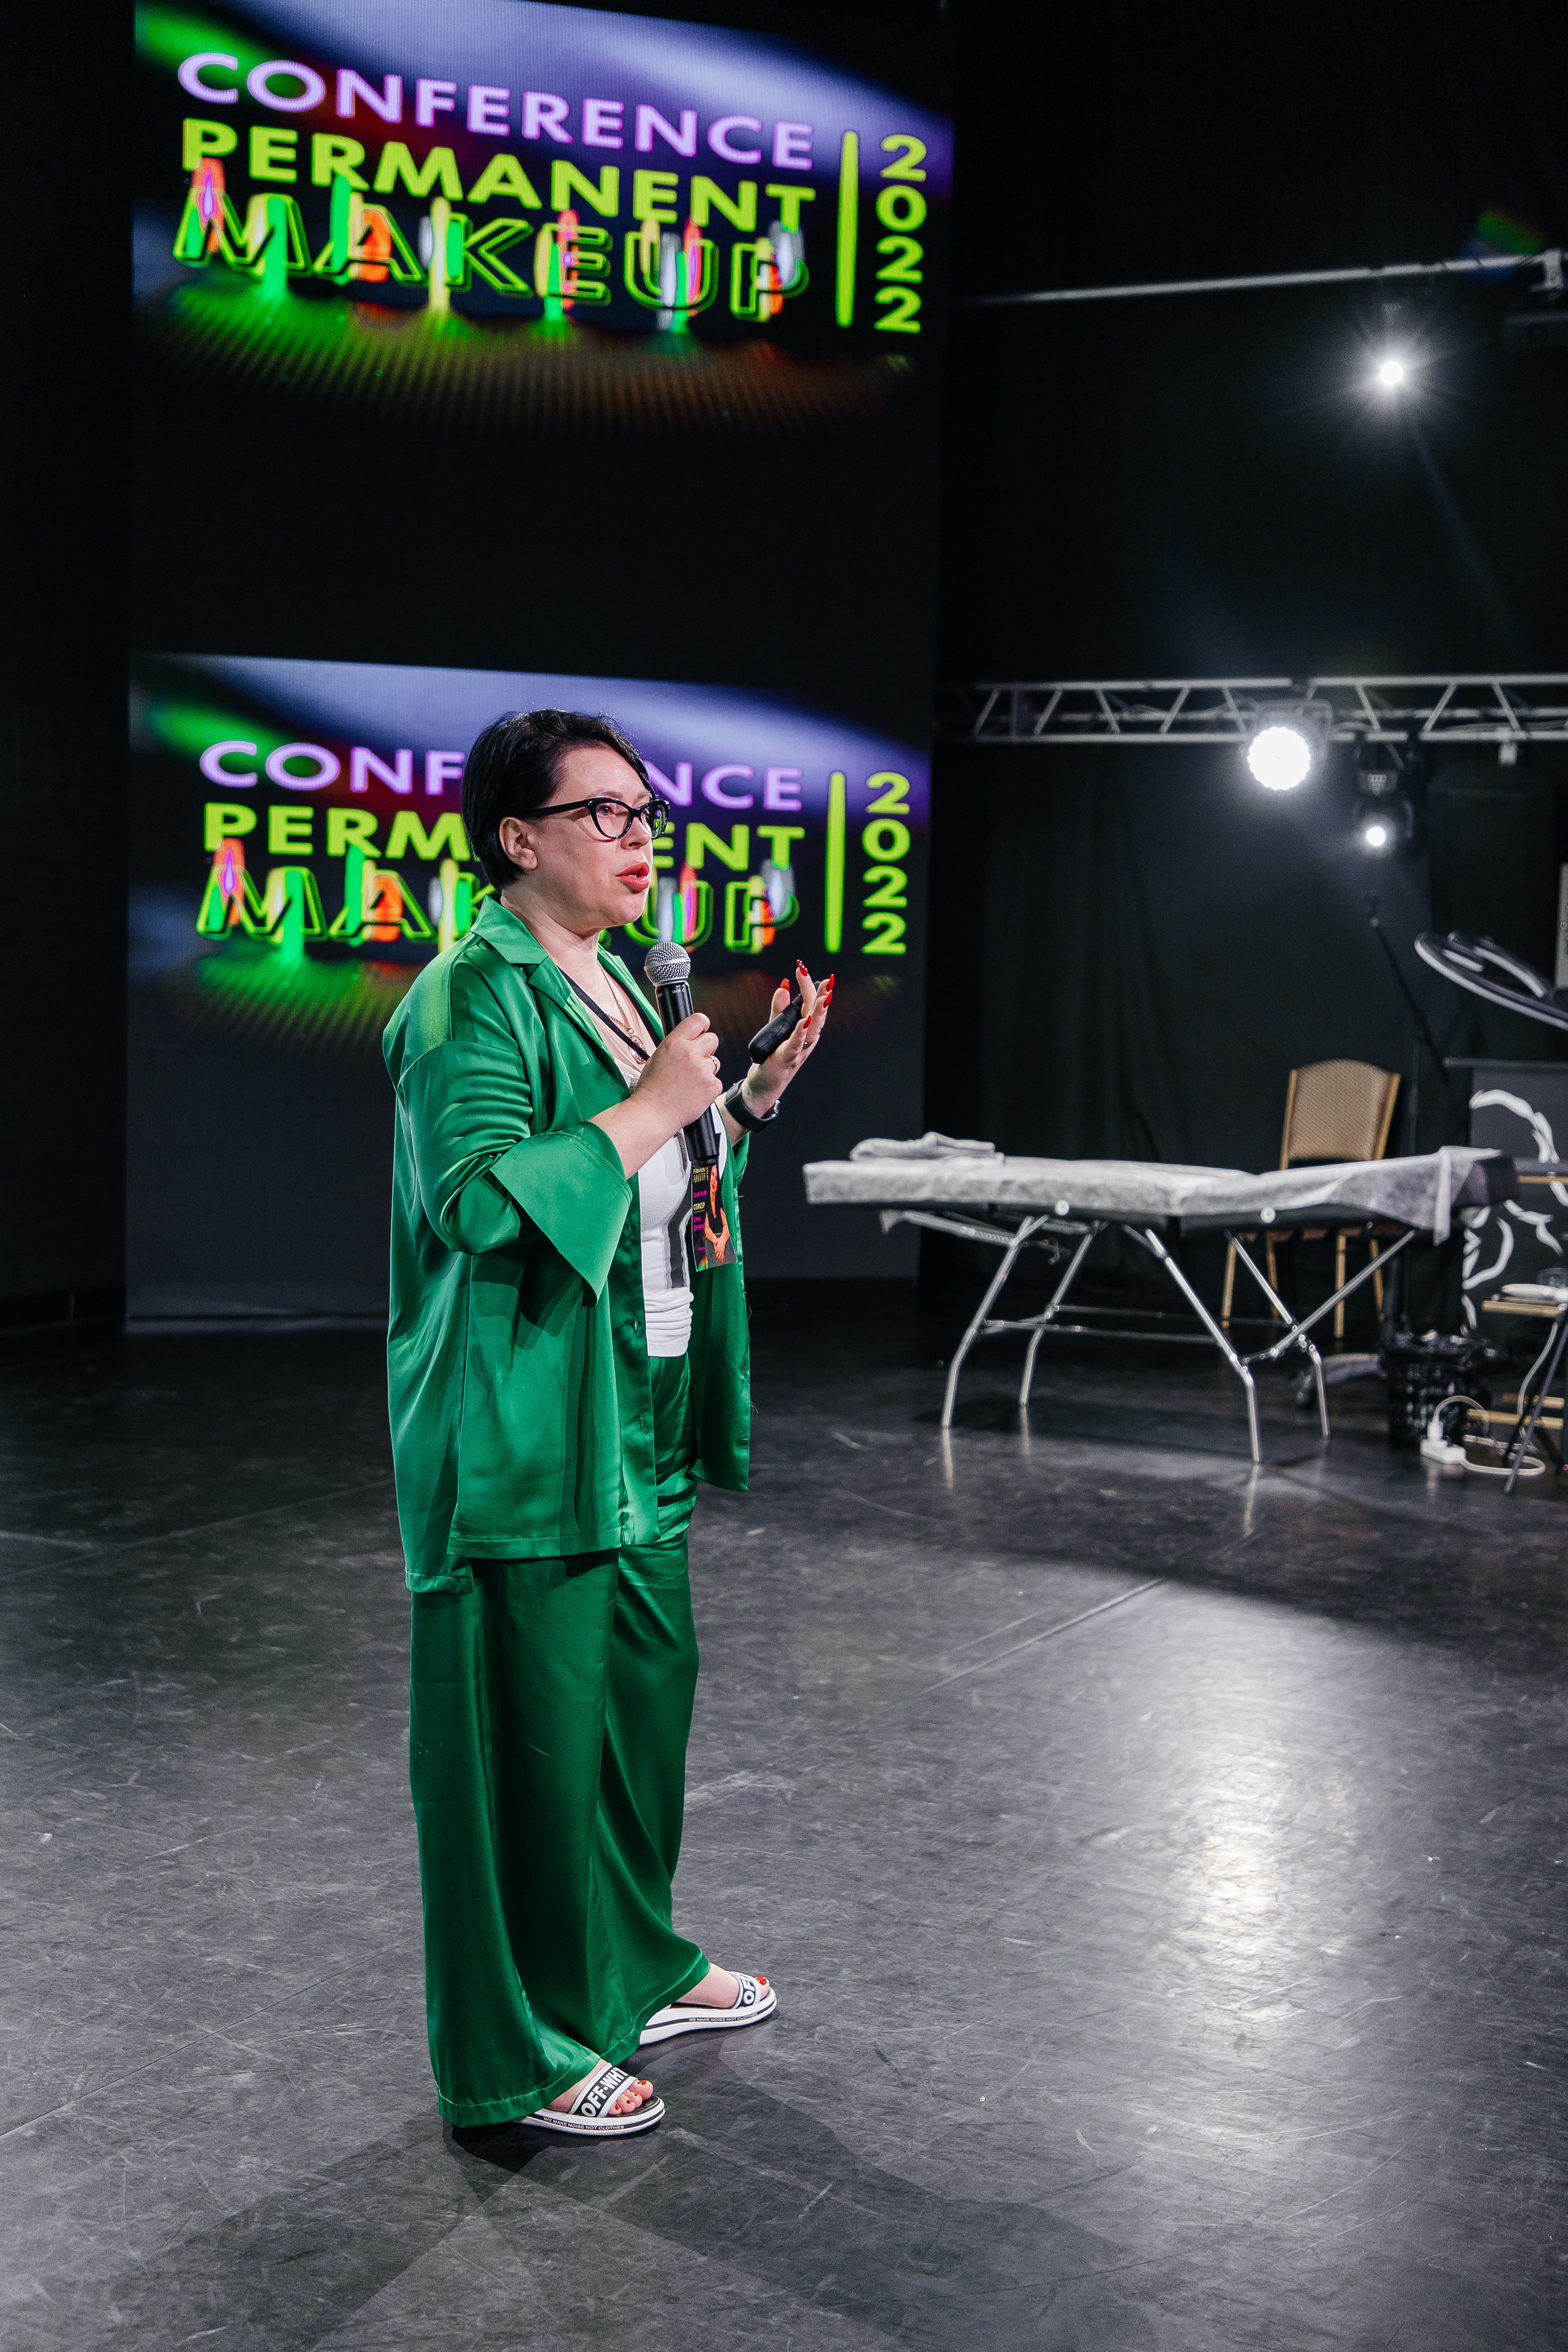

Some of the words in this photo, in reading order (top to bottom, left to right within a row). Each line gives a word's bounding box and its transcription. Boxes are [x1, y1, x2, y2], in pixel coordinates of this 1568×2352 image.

[178, 53, 812, 170] CONFERENCE
[183, 118, 816, 233] PERMANENT
[874, 134, 927, 333] 2022
[200, 741, 802, 811] CONFNCE
[204, 802, 805, 871] PERMNT
[861, 771, 911, 955] 2022
